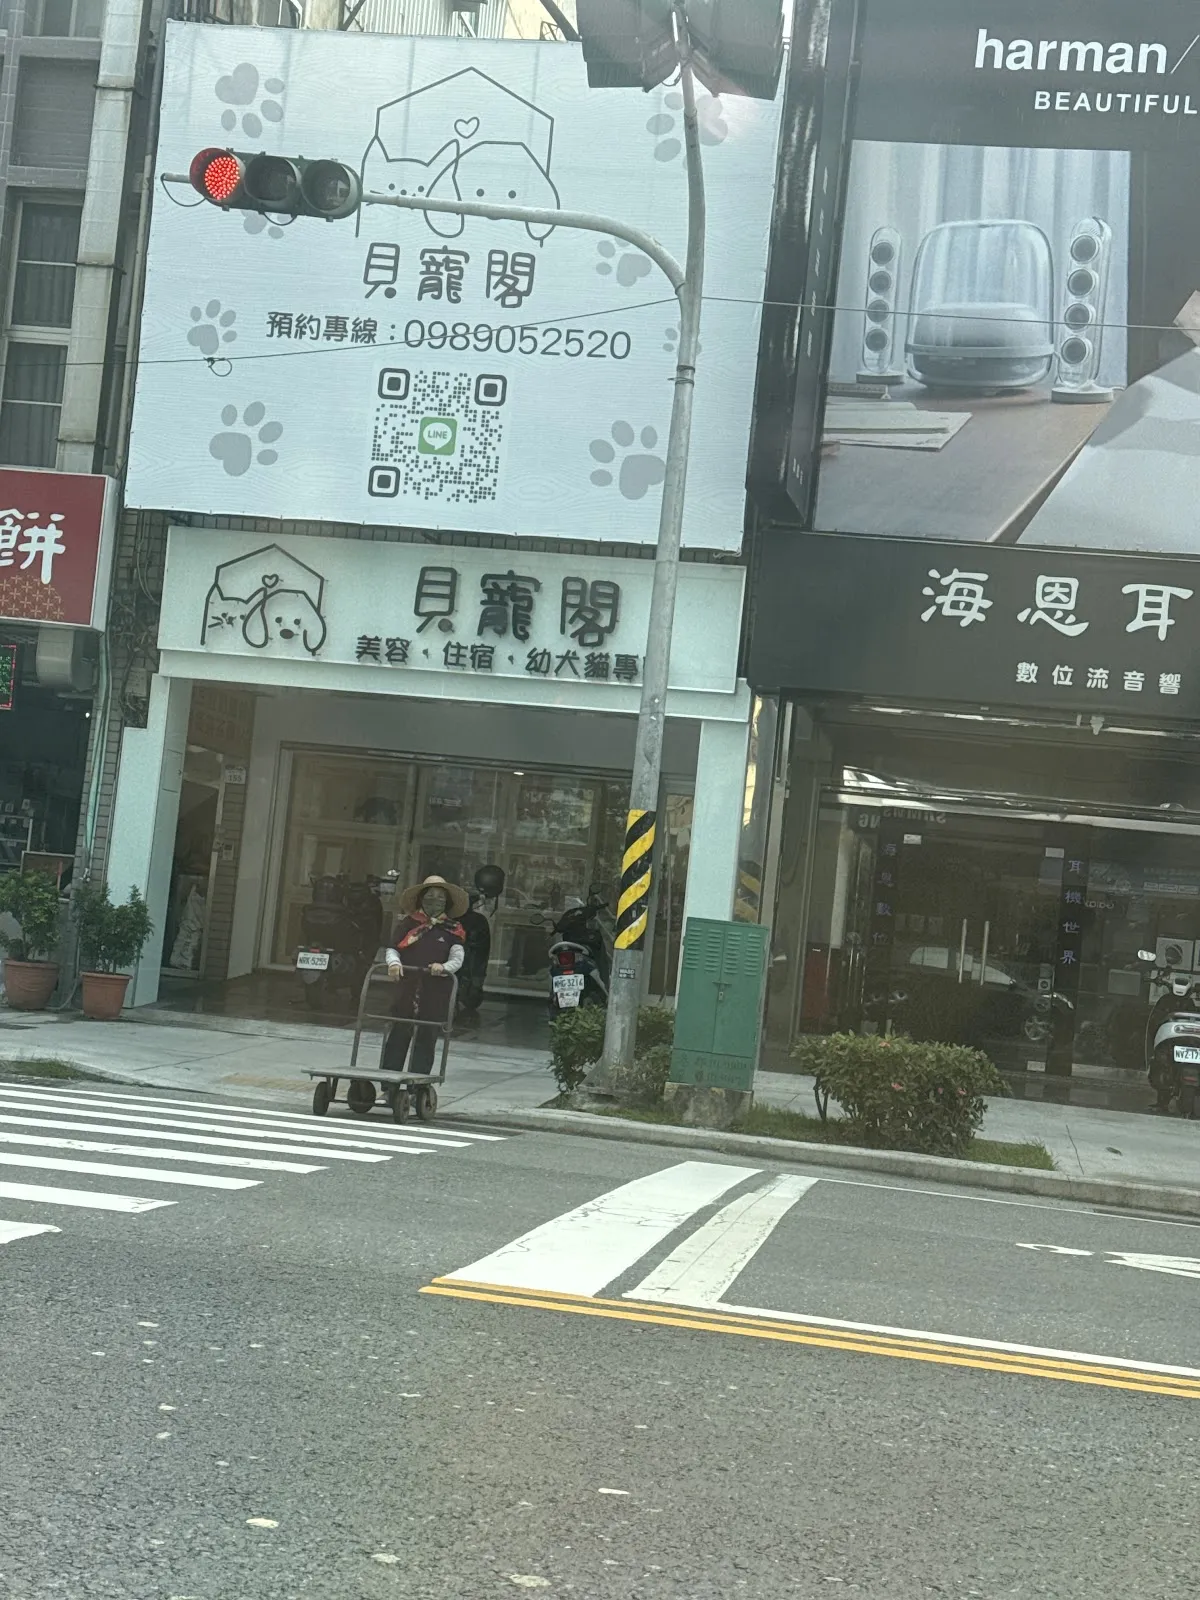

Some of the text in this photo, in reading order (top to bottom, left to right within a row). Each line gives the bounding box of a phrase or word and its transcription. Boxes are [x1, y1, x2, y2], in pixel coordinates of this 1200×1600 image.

[1034, 90, 1198, 114] BEAUTIFUL
[363, 242, 536, 308] 貝寵閣
[427, 429, 448, 440] LINE
[413, 566, 620, 647] 貝寵閣
[920, 568, 1194, 641] 海恩耳
[1016, 662, 1182, 695] 數位流音響
